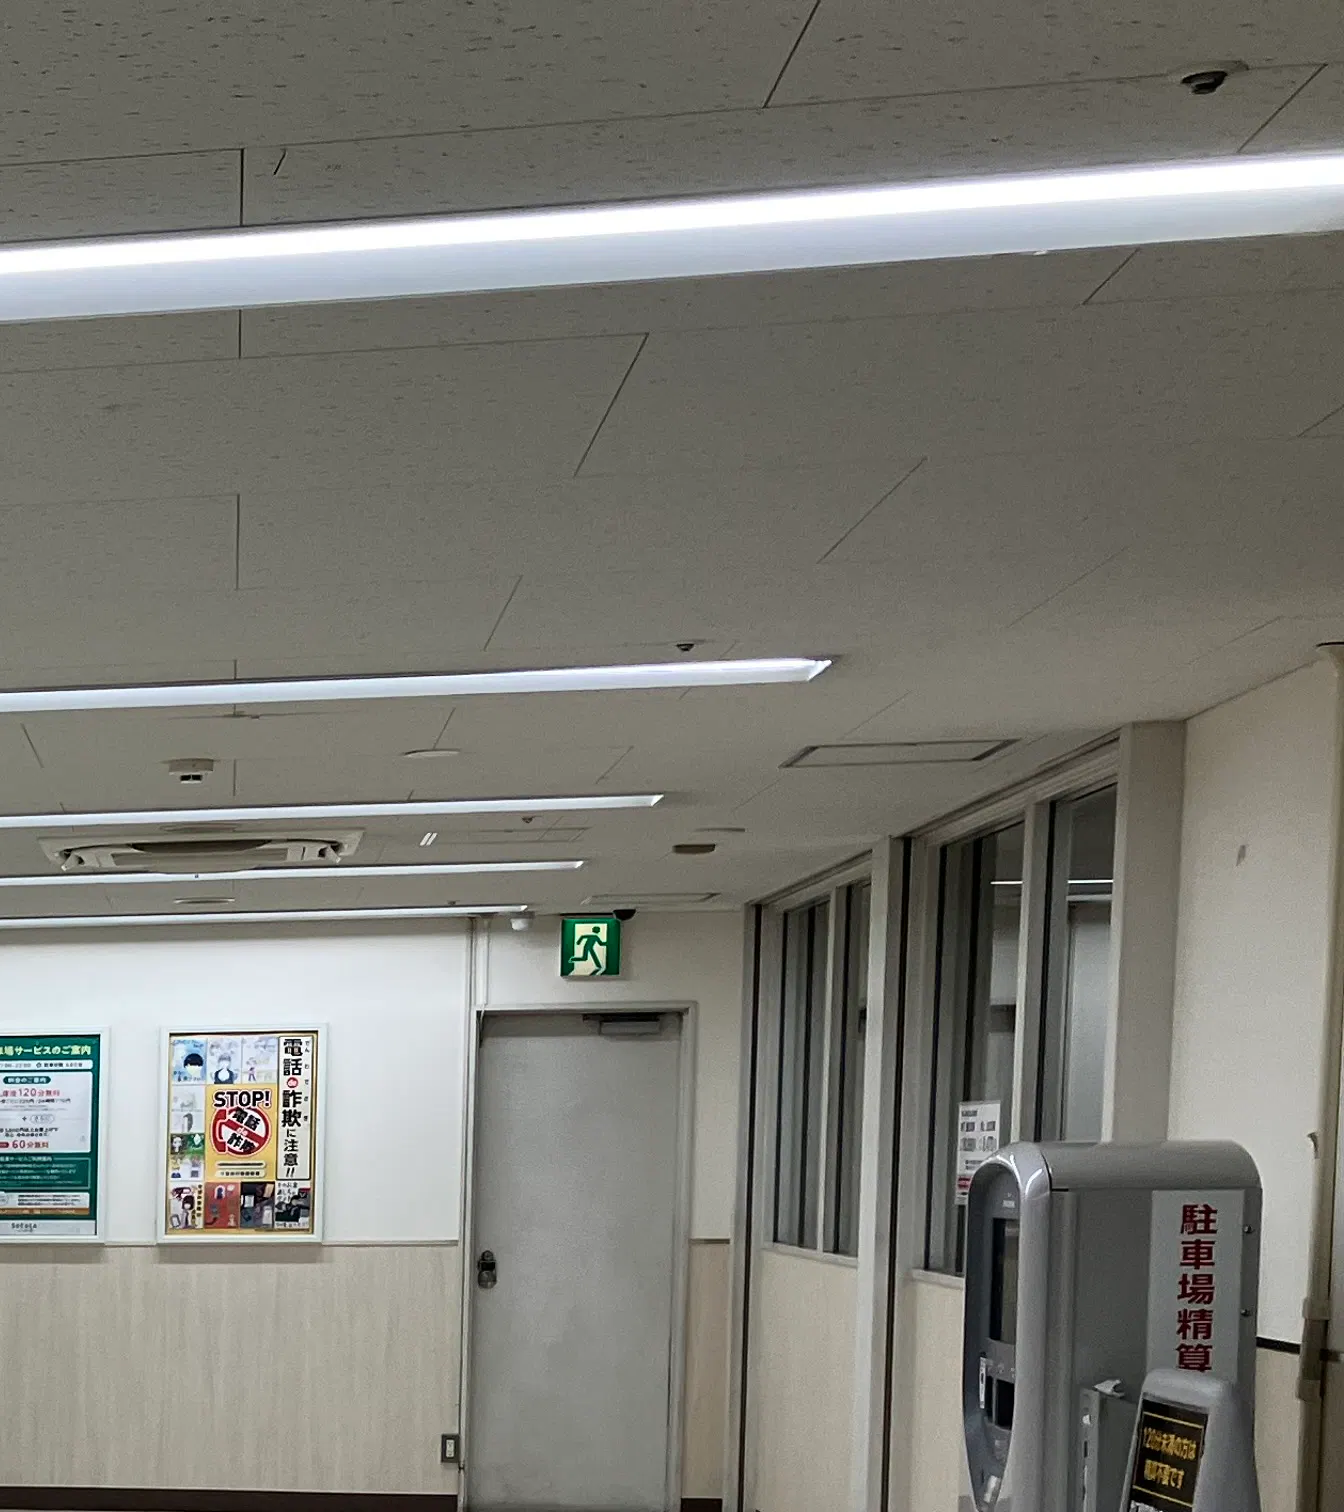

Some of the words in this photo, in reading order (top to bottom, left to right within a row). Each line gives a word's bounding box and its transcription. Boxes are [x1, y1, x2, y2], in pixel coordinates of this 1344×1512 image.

[214, 1091, 270, 1107] STOP!
[1175, 1203, 1218, 1373] 駐車場精算
